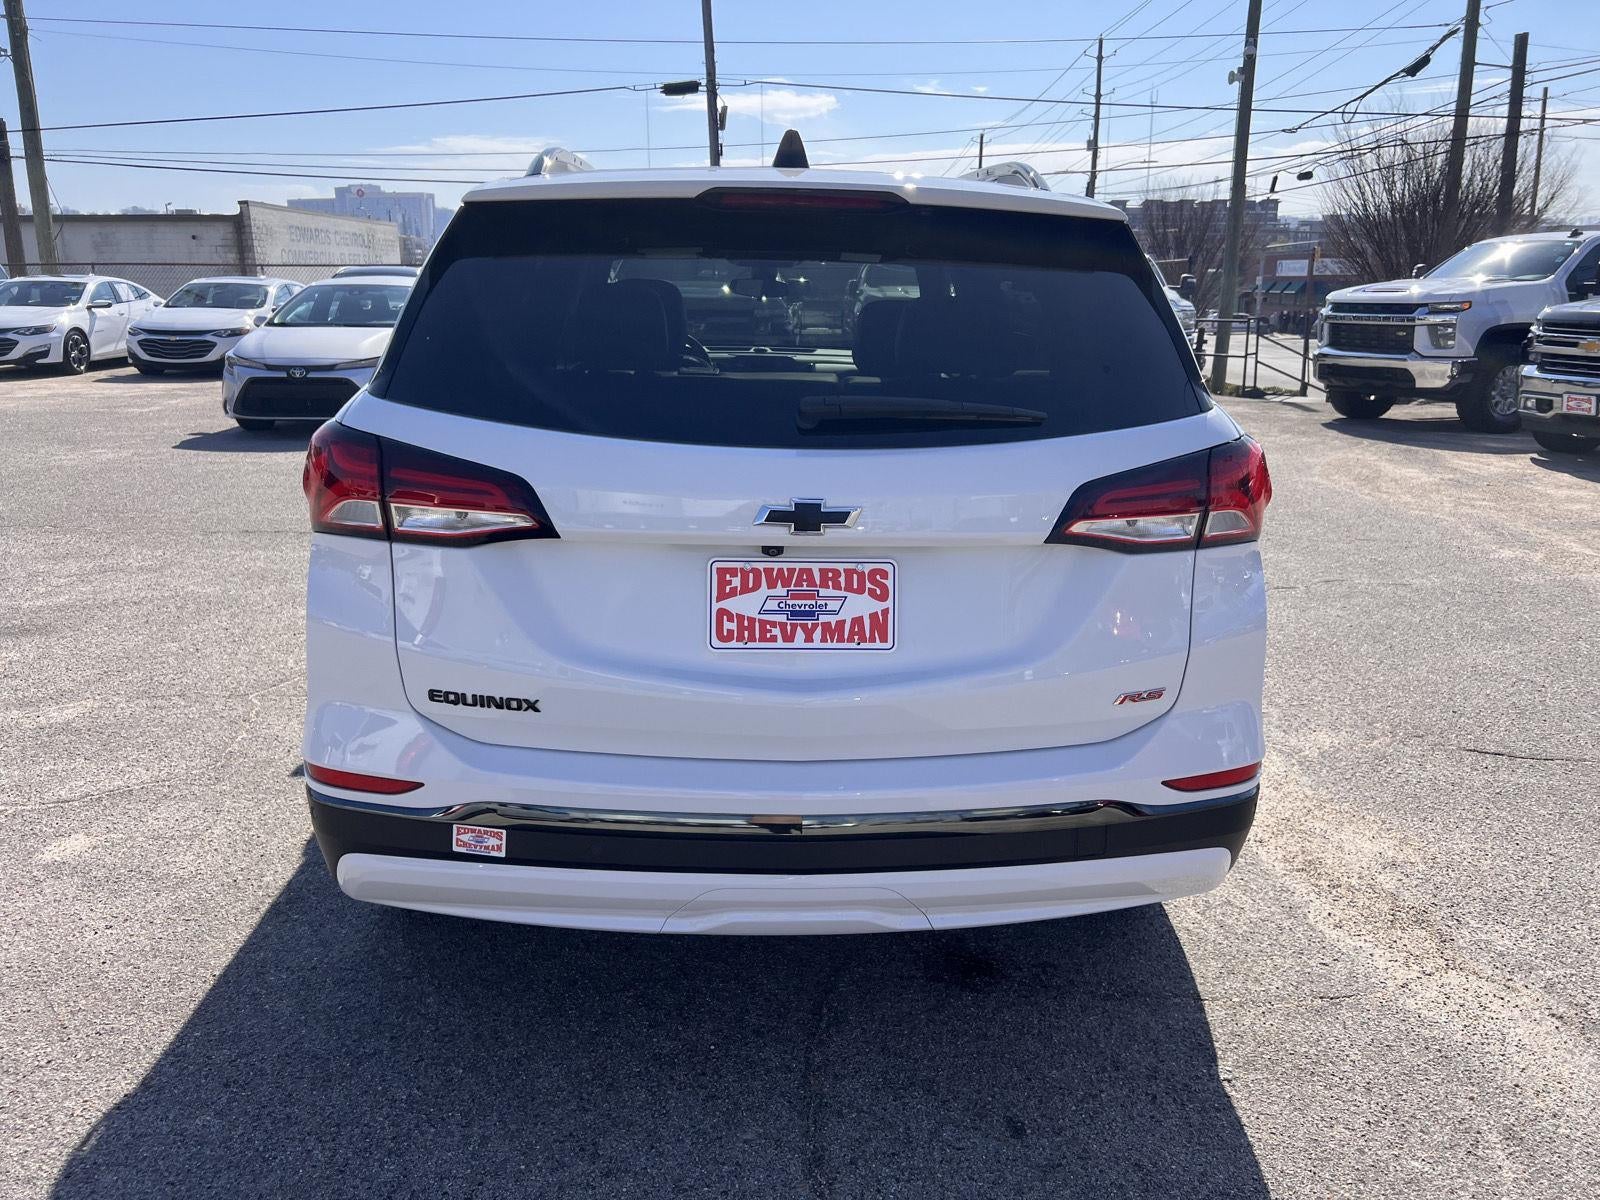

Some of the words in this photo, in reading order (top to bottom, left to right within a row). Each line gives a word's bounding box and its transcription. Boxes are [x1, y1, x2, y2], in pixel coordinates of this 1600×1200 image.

[288, 224, 332, 245] EDWARDS
[716, 567, 890, 603] EDWARDS
[777, 600, 828, 610] Chevrolet
[716, 607, 890, 643] CHEVYMAN
[428, 688, 541, 712] EQUINOX
[1113, 687, 1166, 705] RS
[456, 826, 503, 841] EDWARDS
[456, 837, 503, 853] CHEVYMAN
